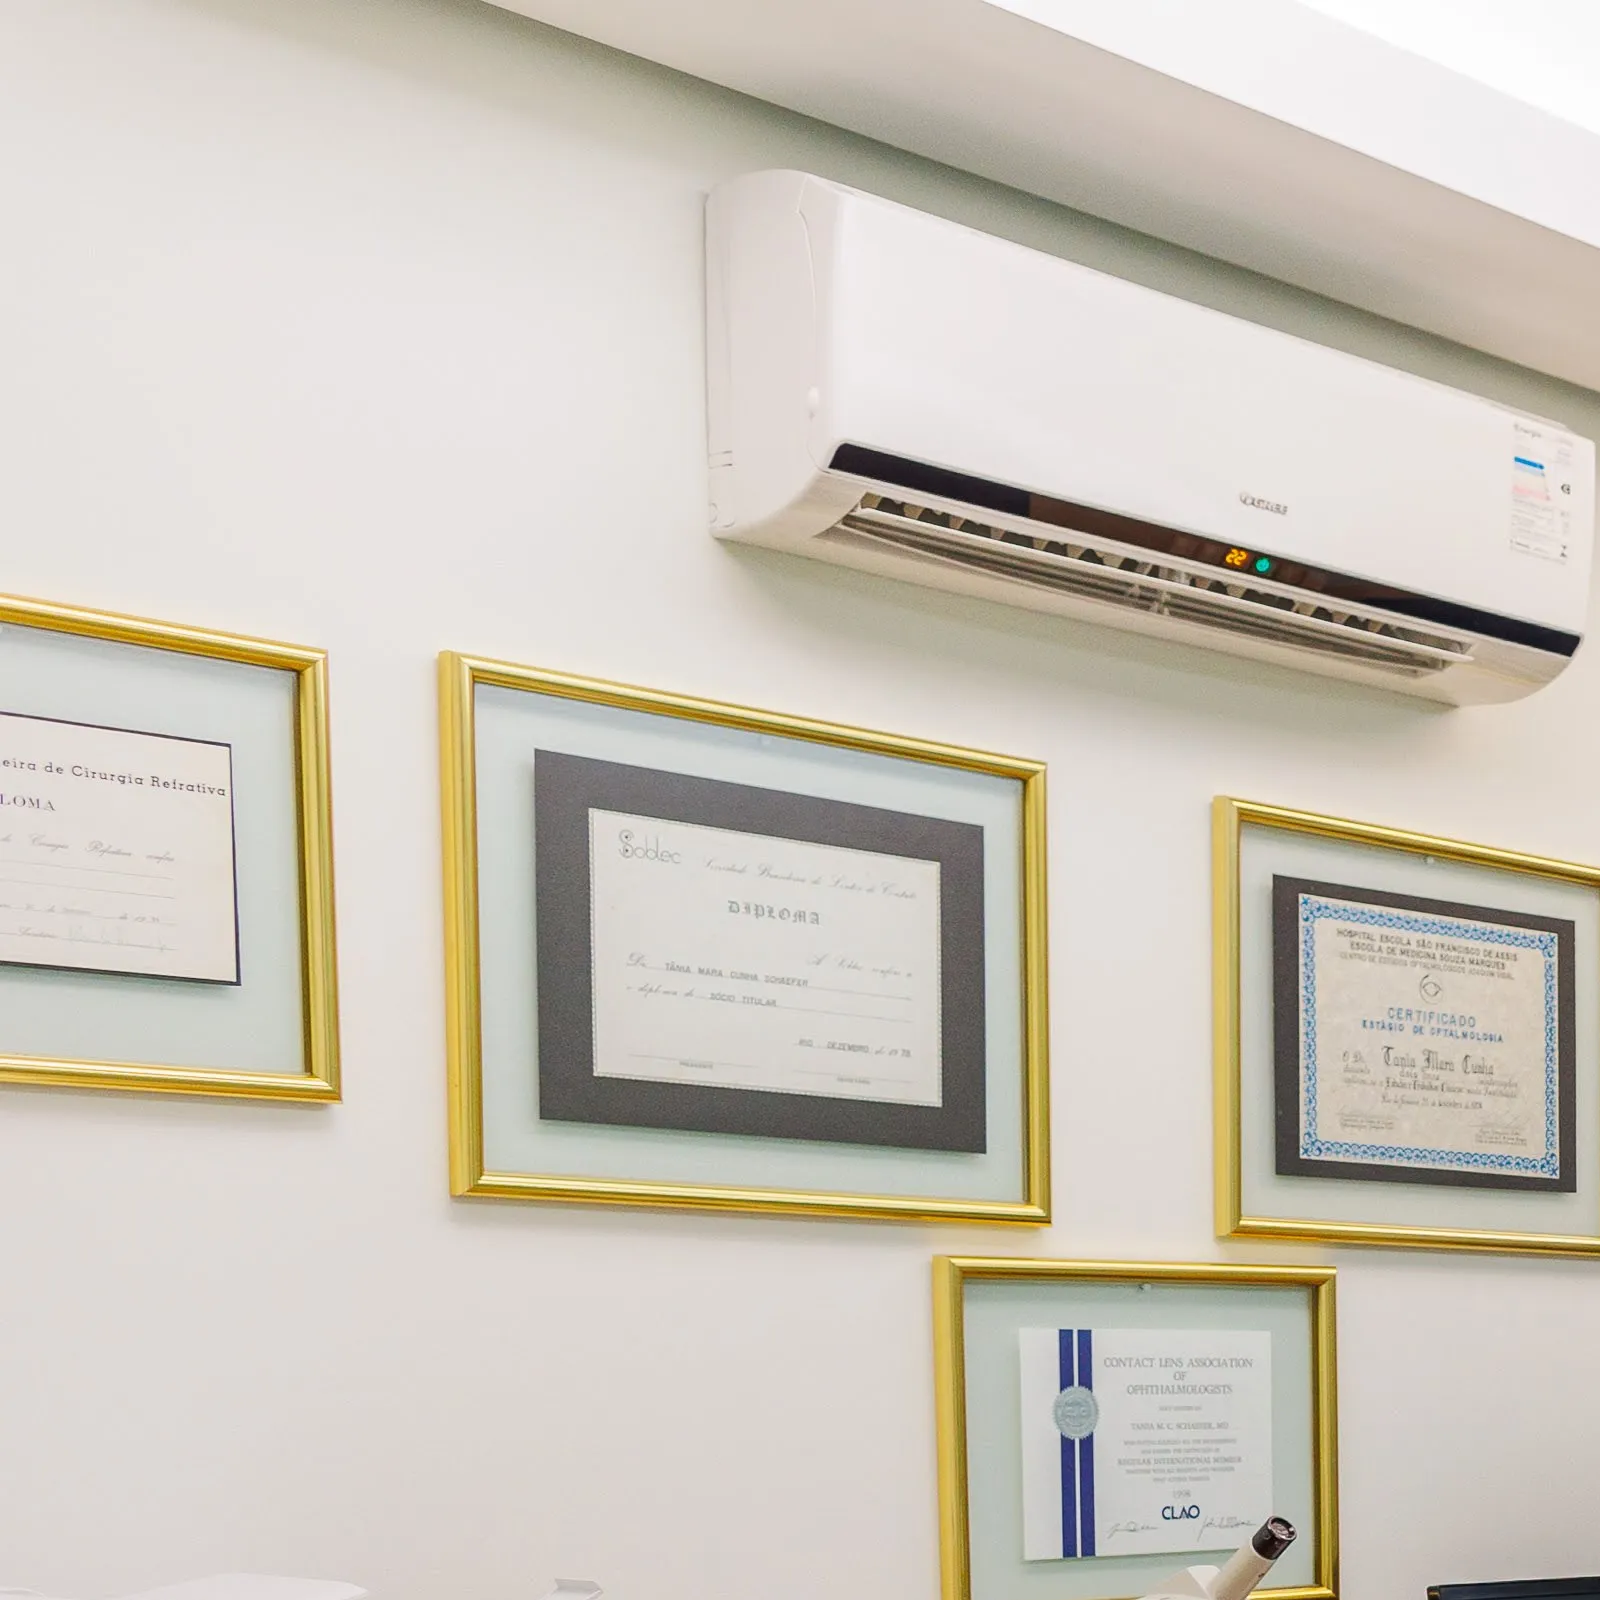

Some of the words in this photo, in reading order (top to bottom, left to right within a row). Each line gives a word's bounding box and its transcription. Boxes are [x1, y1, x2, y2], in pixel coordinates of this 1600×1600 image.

[1225, 547, 1247, 566] 22
[44, 761, 64, 774] de
[71, 765, 145, 786] Cirurgia
[150, 775, 227, 797] Refrativa
[727, 900, 822, 925] DIPLOMA
[1388, 1007, 1476, 1028] CERTIFICADO
[1431, 1026, 1504, 1042] OFTALMOLOGIA
[1104, 1357, 1155, 1368] CONTACT
[1159, 1358, 1184, 1368] LENS
[1187, 1358, 1254, 1368] ASSOCIATION
[1173, 1371, 1187, 1381] OF
[1127, 1384, 1233, 1396] OPHTHALMOLOGISTS
[1161, 1504, 1200, 1520] CLAO
